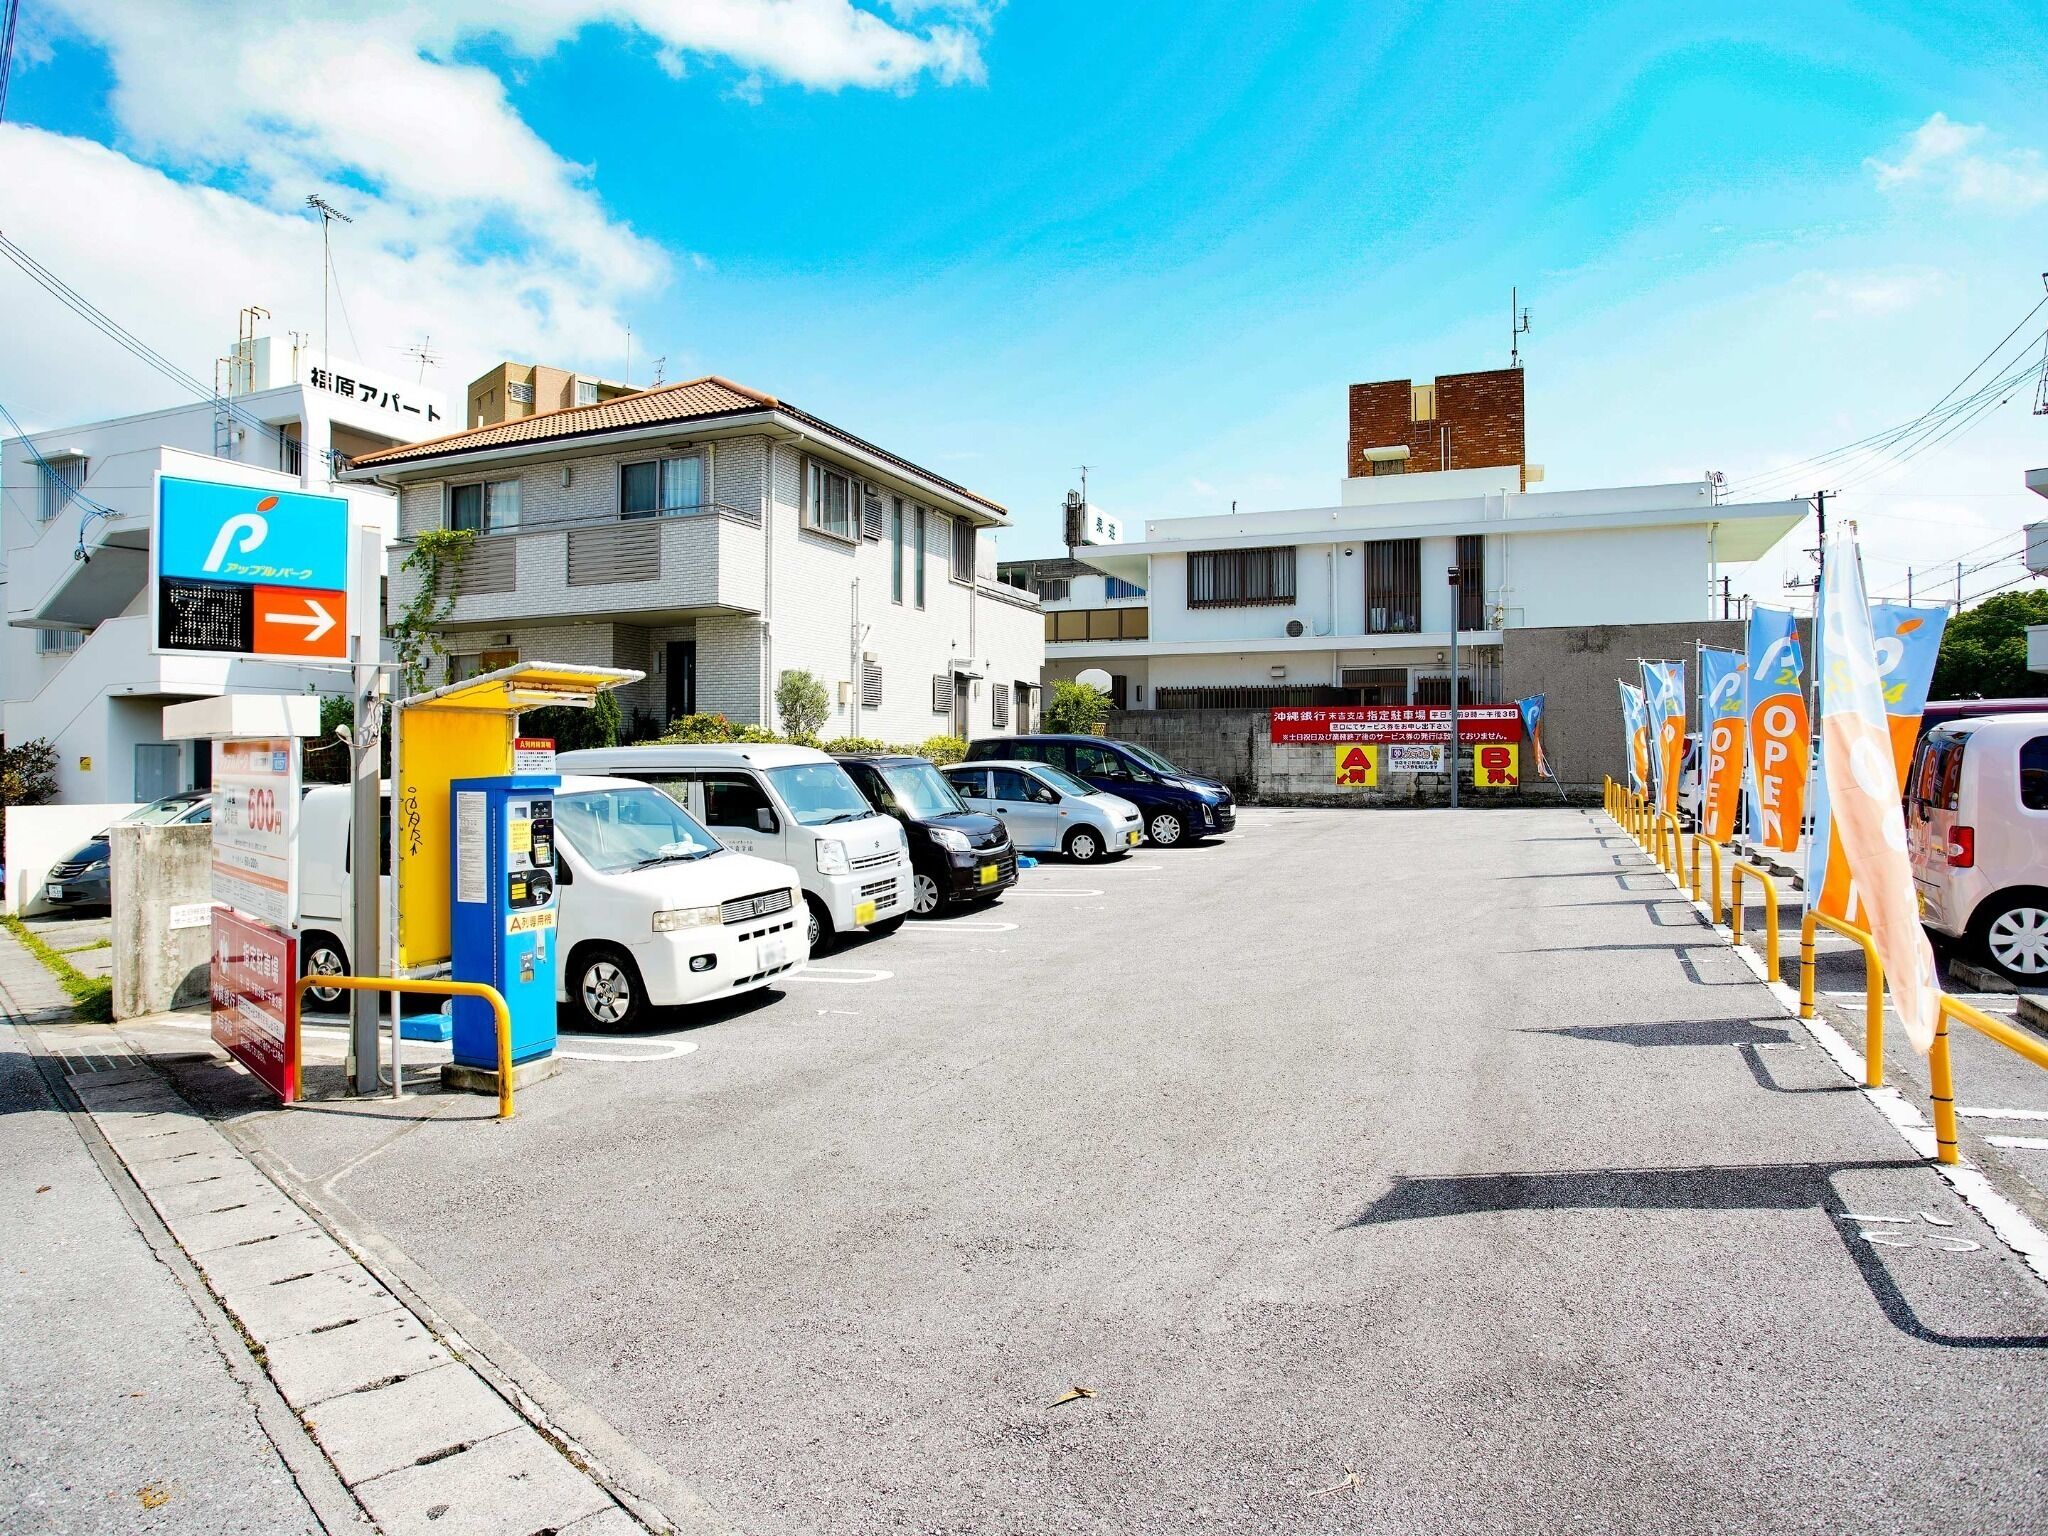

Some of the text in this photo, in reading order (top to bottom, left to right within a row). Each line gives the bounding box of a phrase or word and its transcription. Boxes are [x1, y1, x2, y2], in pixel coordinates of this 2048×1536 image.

[224, 562, 312, 580] アップルパーク
[1274, 711, 1326, 721] 沖縄銀行
[1367, 710, 1426, 721] 指定駐車場
[1342, 747, 1371, 769] A
[1481, 747, 1511, 768] B
[1348, 769, 1366, 784] 列
[1487, 769, 1505, 784] 列
[1762, 705, 1797, 845] OPEN
